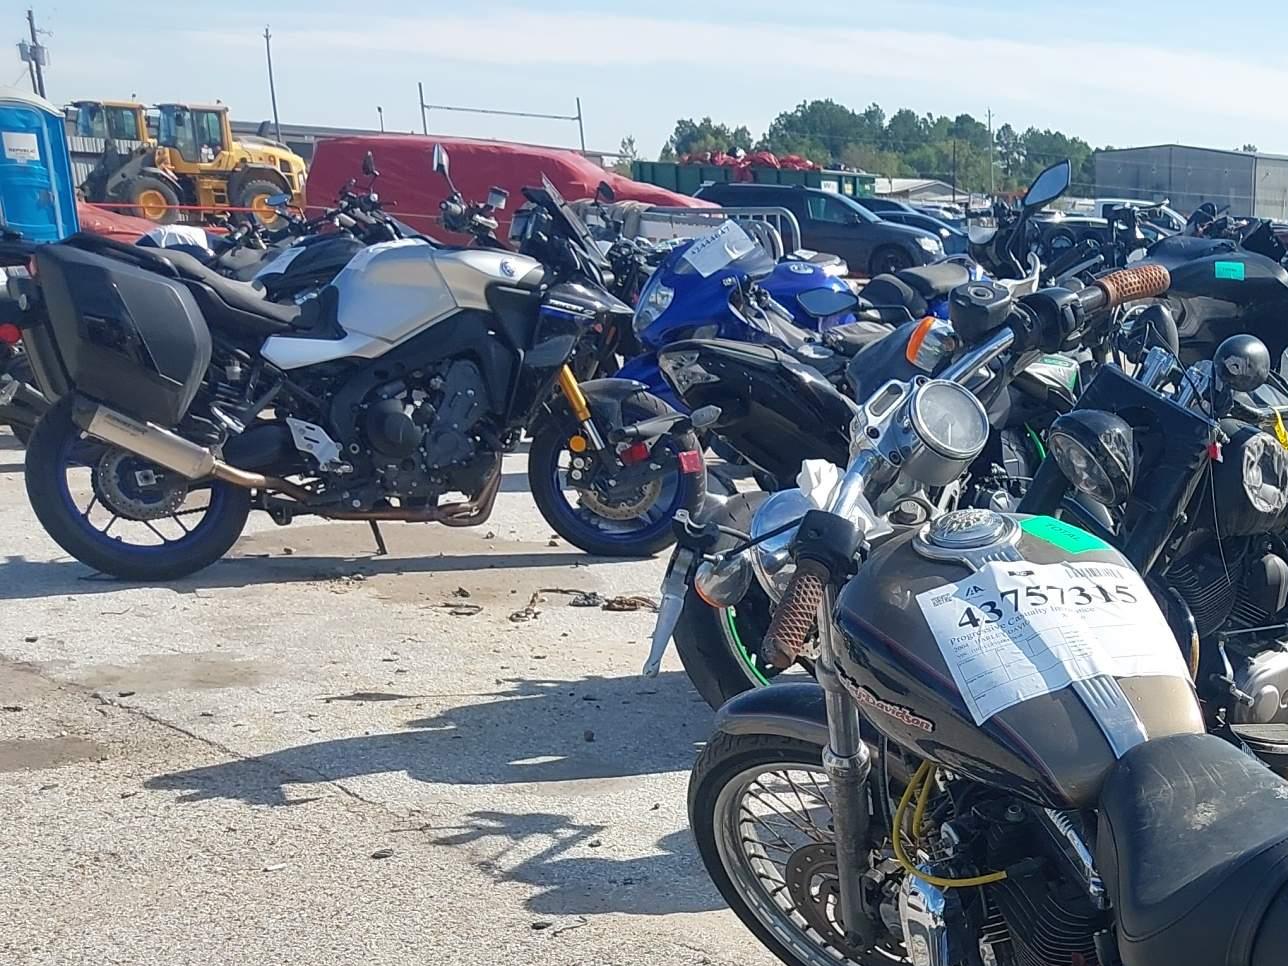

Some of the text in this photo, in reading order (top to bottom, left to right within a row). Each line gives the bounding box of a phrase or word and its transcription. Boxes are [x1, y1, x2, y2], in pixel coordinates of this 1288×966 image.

[1045, 523, 1081, 541] TOTAL
[950, 622, 1008, 646] Progressive
[1007, 607, 1048, 629] Casualty
[957, 585, 1138, 629] 43757315
